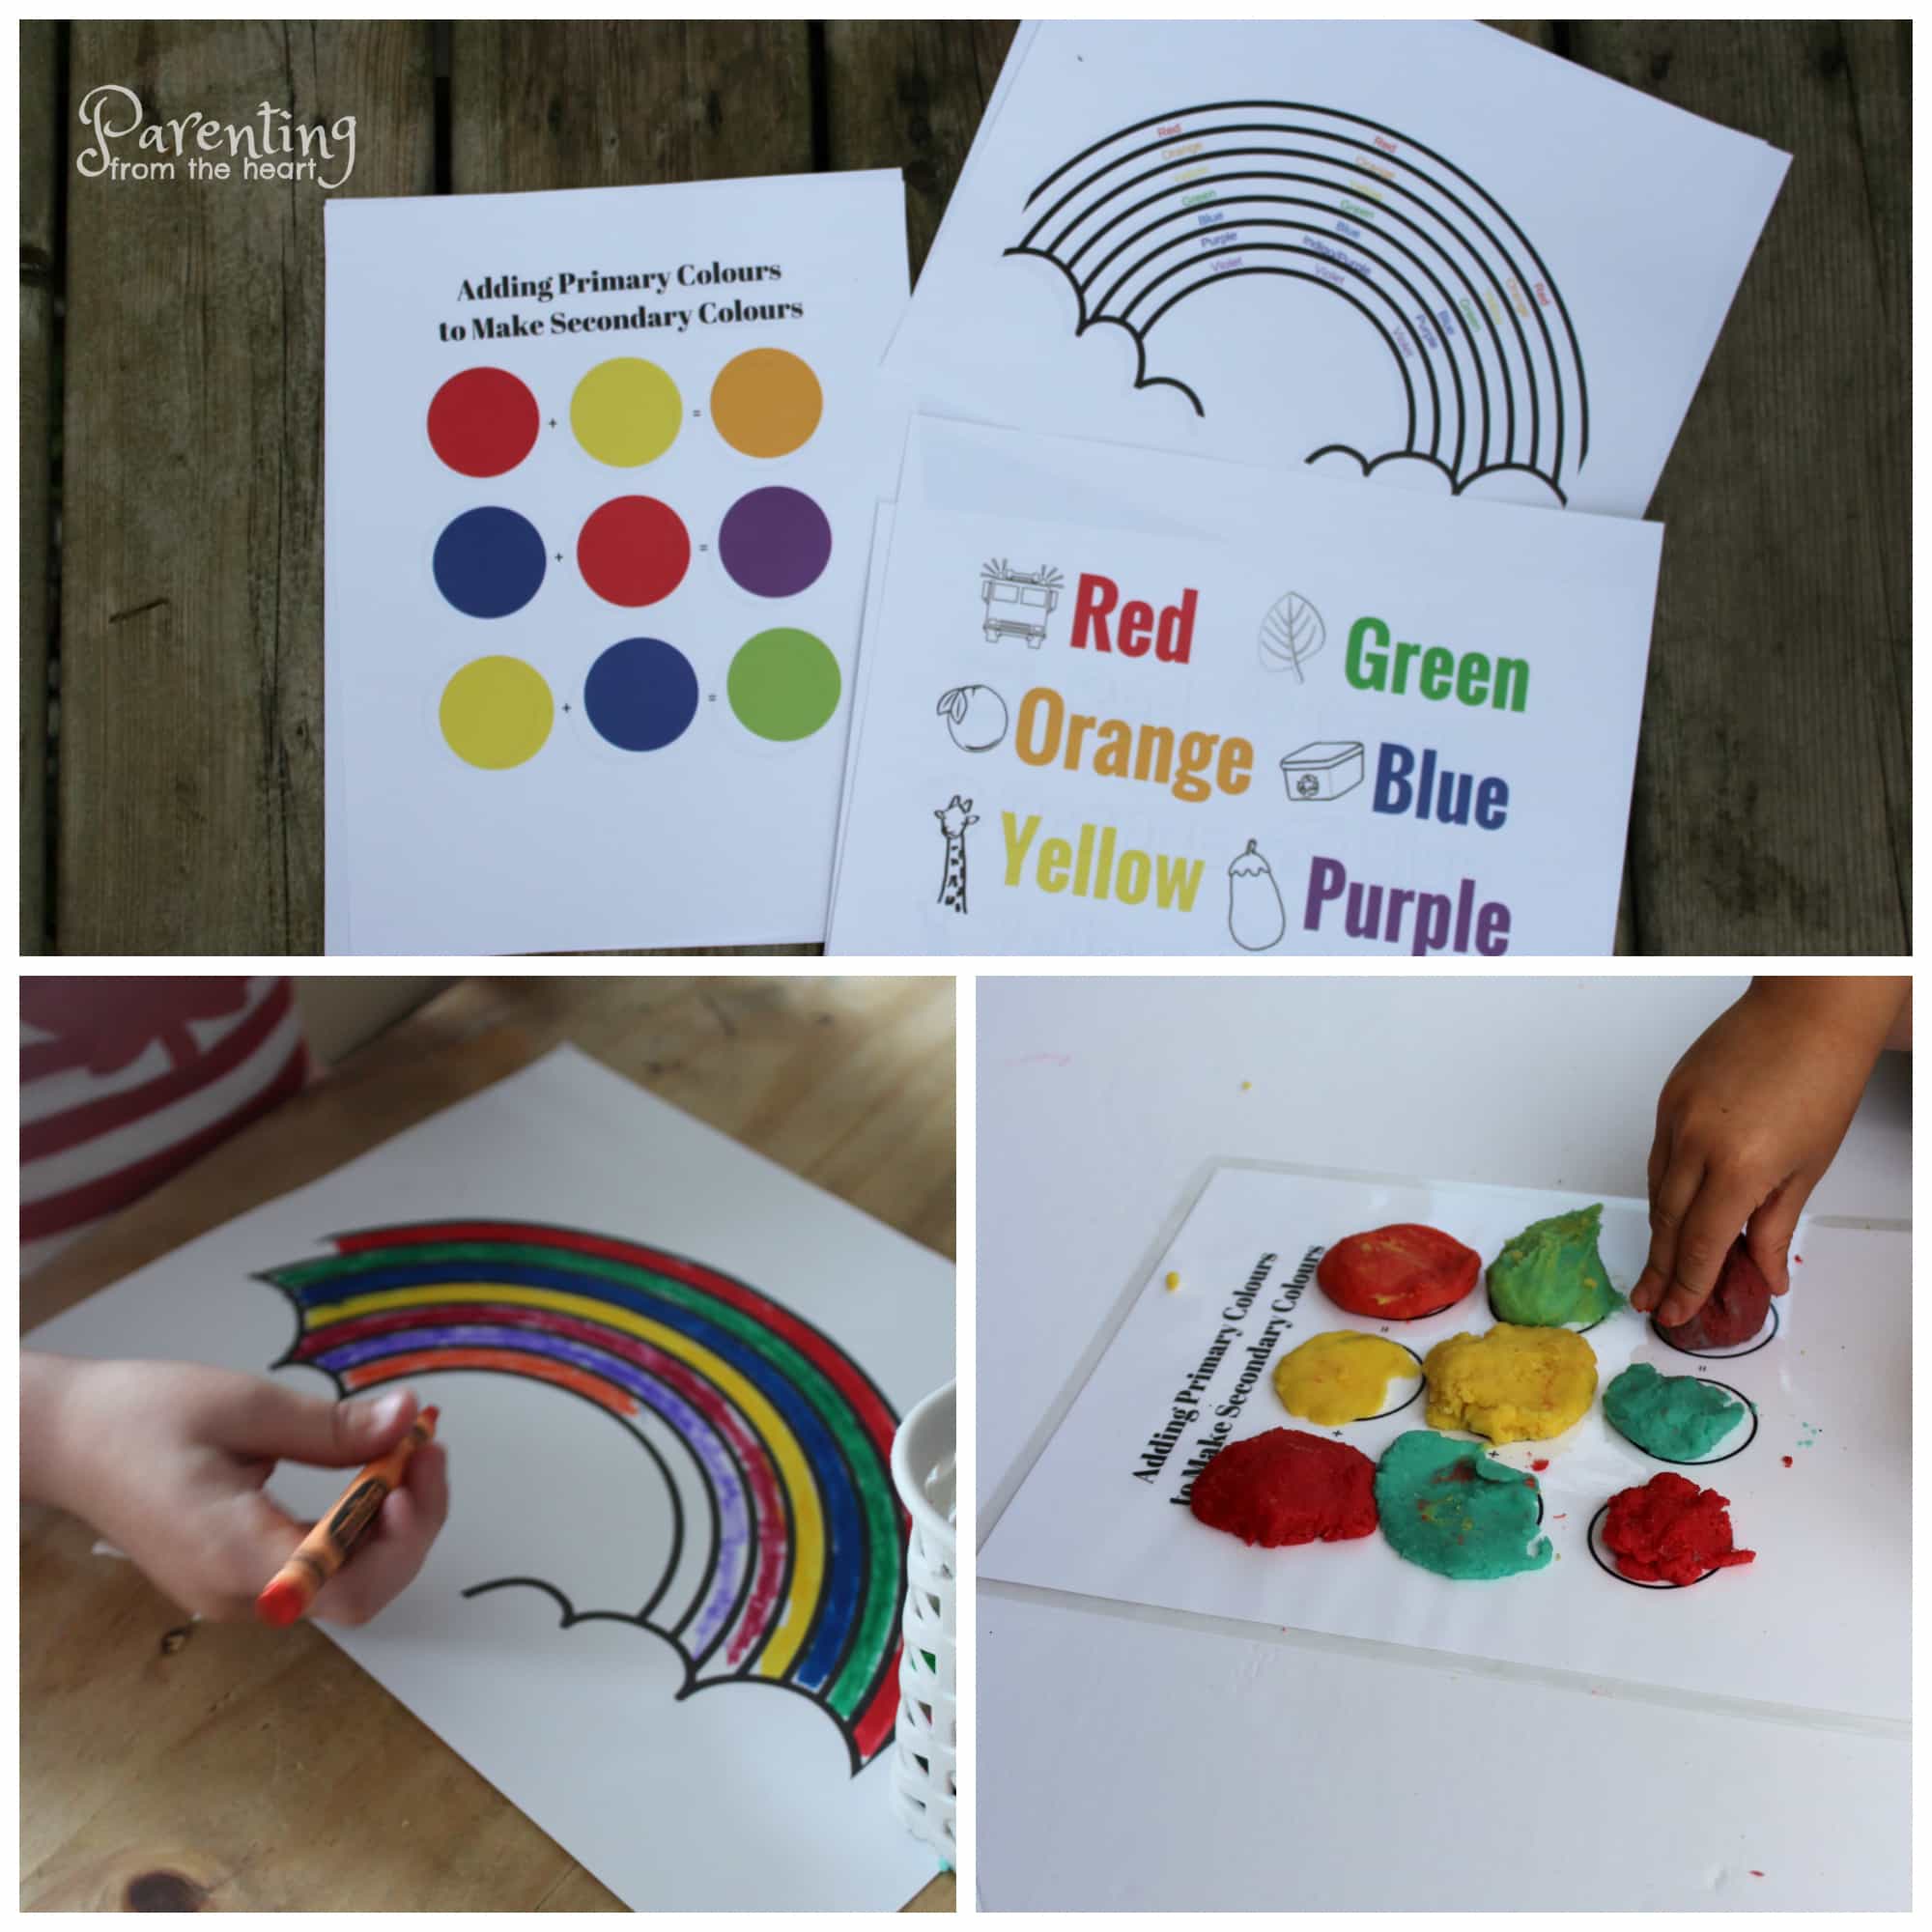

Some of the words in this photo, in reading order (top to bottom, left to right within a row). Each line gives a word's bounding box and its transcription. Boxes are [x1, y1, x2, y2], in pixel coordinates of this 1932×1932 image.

[1198, 212, 1224, 226] Blue
[1201, 232, 1237, 248] Purple
[440, 321, 467, 341] to
[472, 314, 544, 340] Make
[550, 305, 692, 334] Secondary
[698, 299, 804, 325] Colours
[457, 275, 554, 302] Adding
[558, 270, 671, 294] Primary
[677, 262, 781, 286] Colours
[1069, 573, 1199, 665] Red
[1345, 615, 1530, 713] Green
[1014, 687, 1254, 803] Orange
[1373, 742, 1509, 831] Blue
[1001, 810, 1206, 913] Yellow
[1303, 856, 1511, 956] Purple
[1131, 1406, 1200, 1485] Adding
[1174, 1323, 1243, 1406] Primary
[1222, 1252, 1278, 1321] Colours
[1181, 1421, 1233, 1477] Make
[1215, 1315, 1293, 1418] Secondary
[1271, 1244, 1324, 1314] Colours
